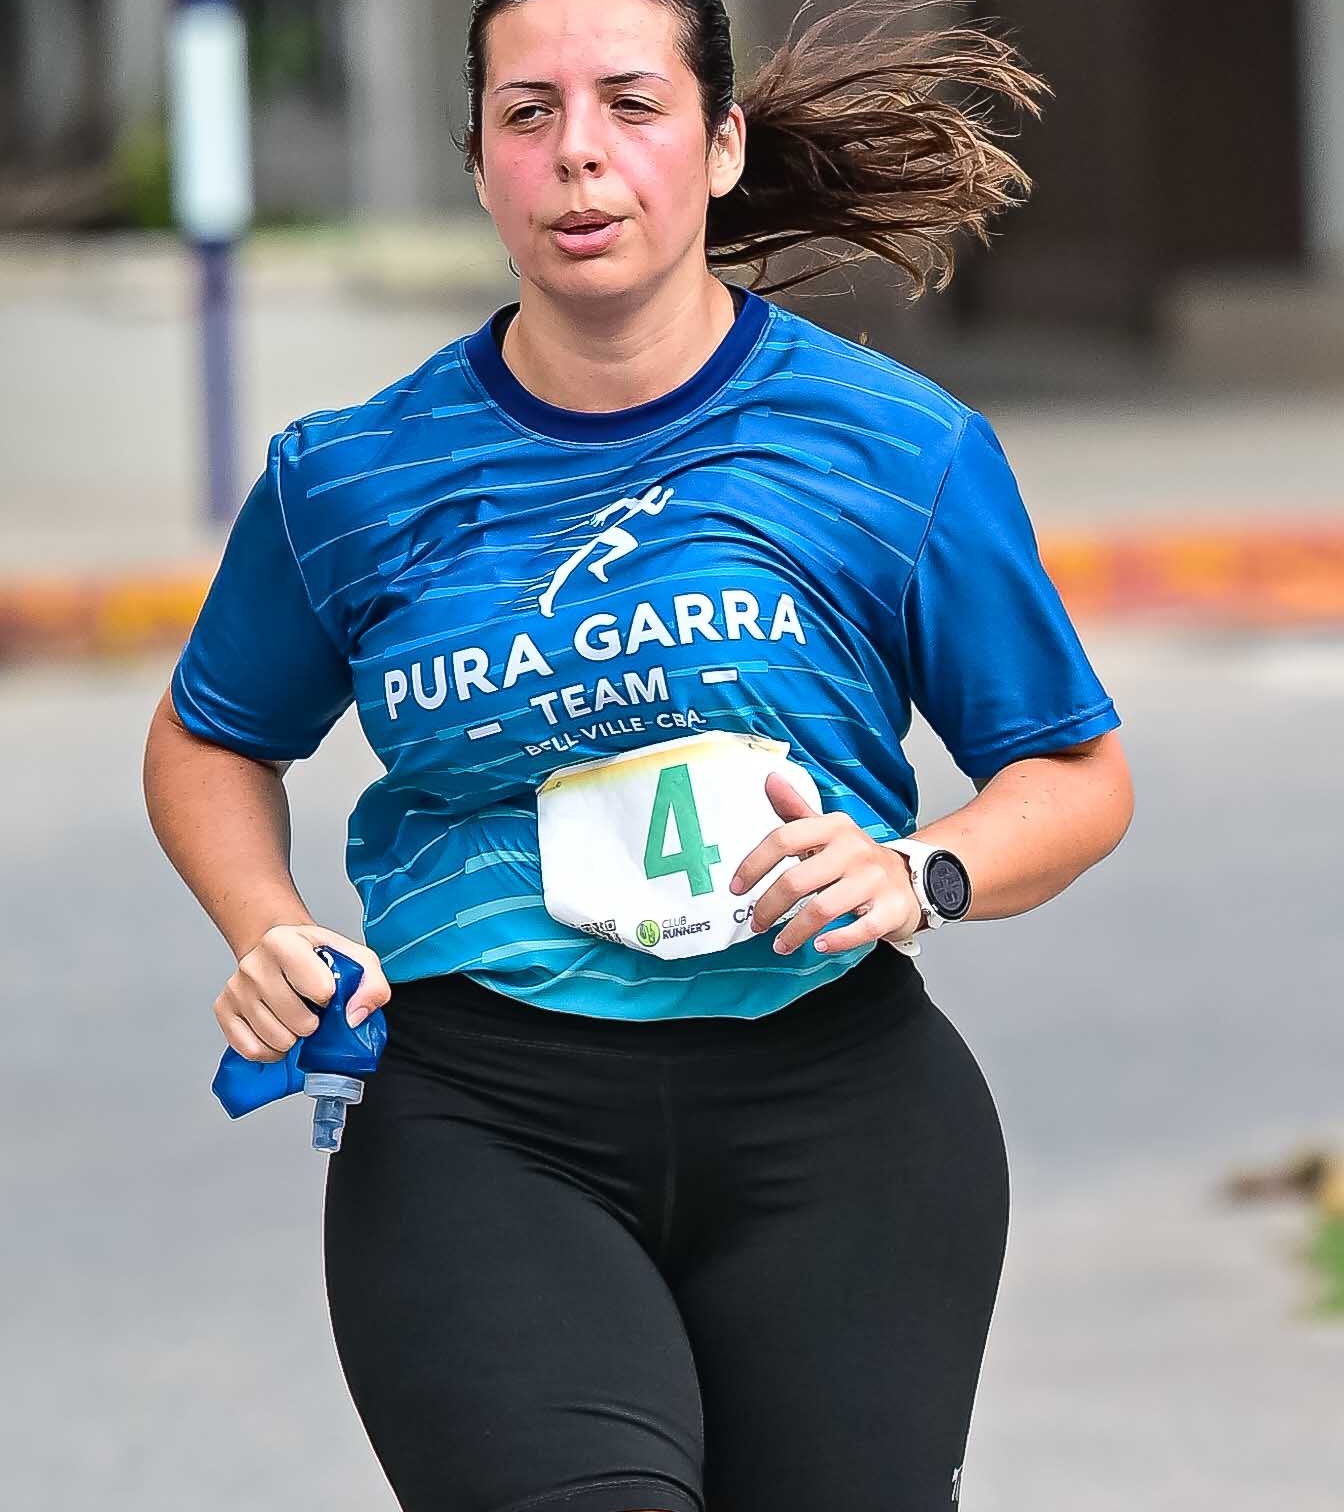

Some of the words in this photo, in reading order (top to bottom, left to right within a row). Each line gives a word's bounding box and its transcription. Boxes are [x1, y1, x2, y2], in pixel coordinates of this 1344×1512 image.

[385, 632, 554, 721] PURA
[573, 589, 807, 662] GARRA
[530, 667, 670, 726] TEAM
[643, 763, 722, 898] 4
[661, 915, 687, 929] CLUB
